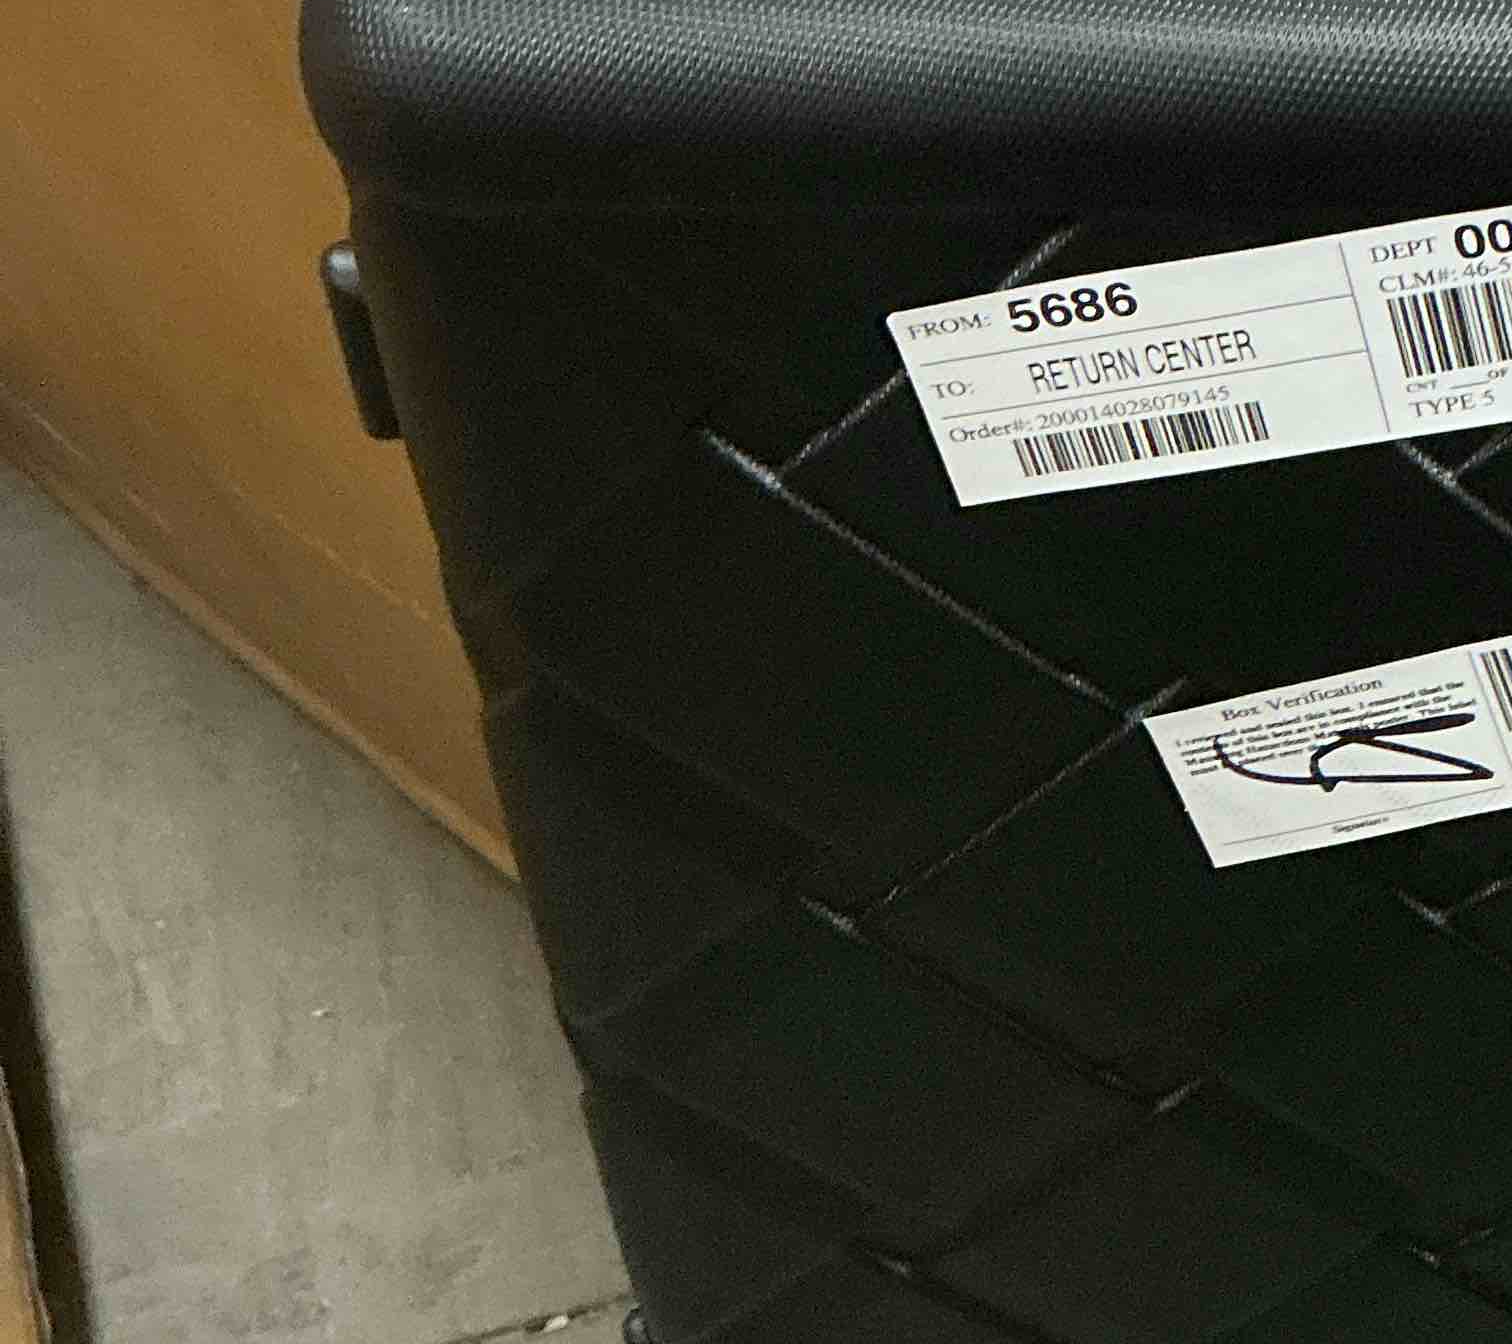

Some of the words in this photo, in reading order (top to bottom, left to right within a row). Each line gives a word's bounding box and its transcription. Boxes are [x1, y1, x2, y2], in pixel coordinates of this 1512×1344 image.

[1369, 237, 1439, 265] DEPT
[1378, 267, 1459, 295] CLM#:
[906, 312, 992, 342] FROM:
[1007, 281, 1139, 334] 5686
[929, 378, 974, 400] TO:
[1028, 347, 1141, 395] RETURN
[1145, 328, 1258, 376] CENTER
[1488, 366, 1509, 380] OF
[948, 419, 1033, 445] Order#:
[1037, 384, 1231, 433] 200014028079145
[1410, 395, 1477, 419] TYPE
[1480, 389, 1497, 408] 5
[1220, 705, 1261, 722] Box
[1264, 677, 1383, 712] Verification
